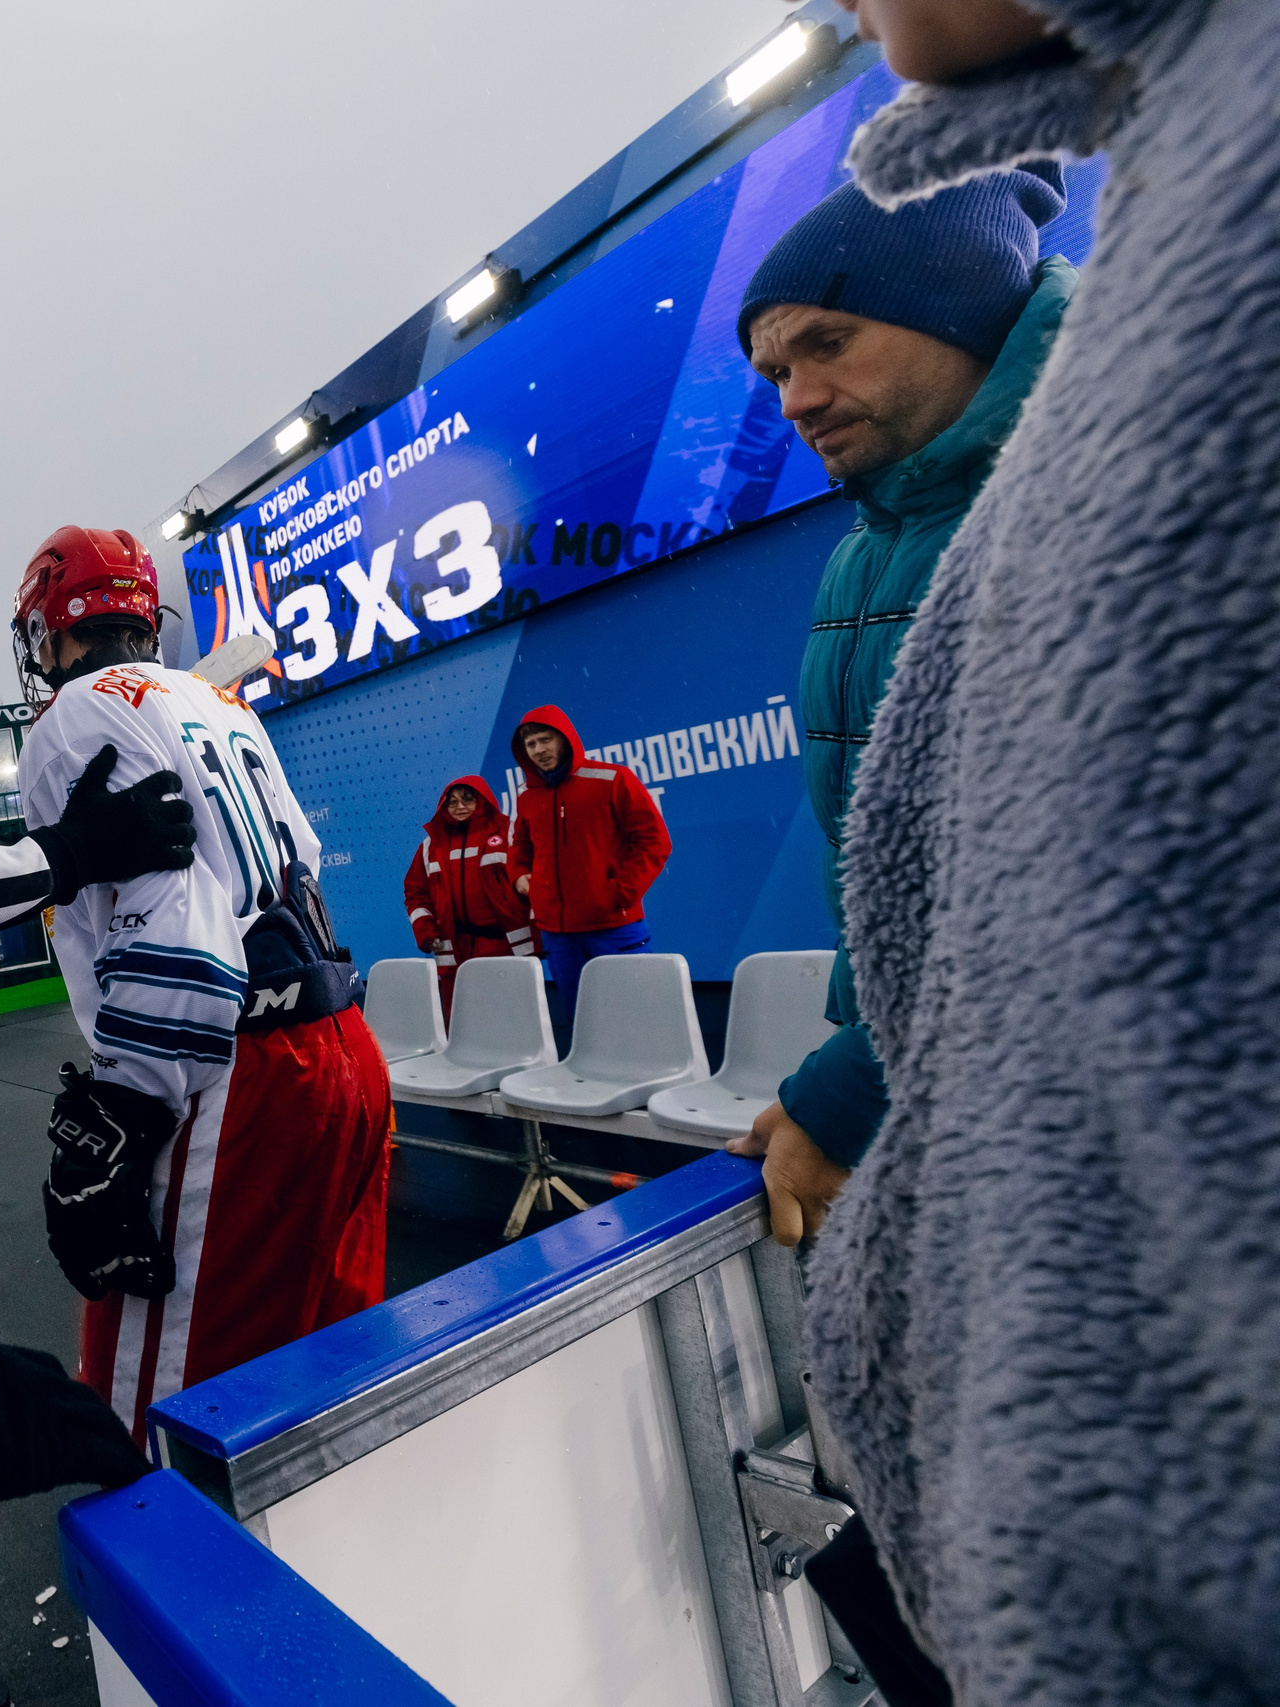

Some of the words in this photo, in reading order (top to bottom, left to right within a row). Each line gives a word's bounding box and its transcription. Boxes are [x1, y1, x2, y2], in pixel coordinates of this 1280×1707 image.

[258, 476, 310, 526] КУБОК
[264, 465, 383, 555] МОСКОВСКОГО
[386, 411, 470, 479] СПОРТА
[269, 556, 291, 584] ПО
[292, 514, 362, 572] ХОККЕЮ
[584, 694, 801, 785] КОВСКИЙ
[320, 851, 352, 868] сквы
